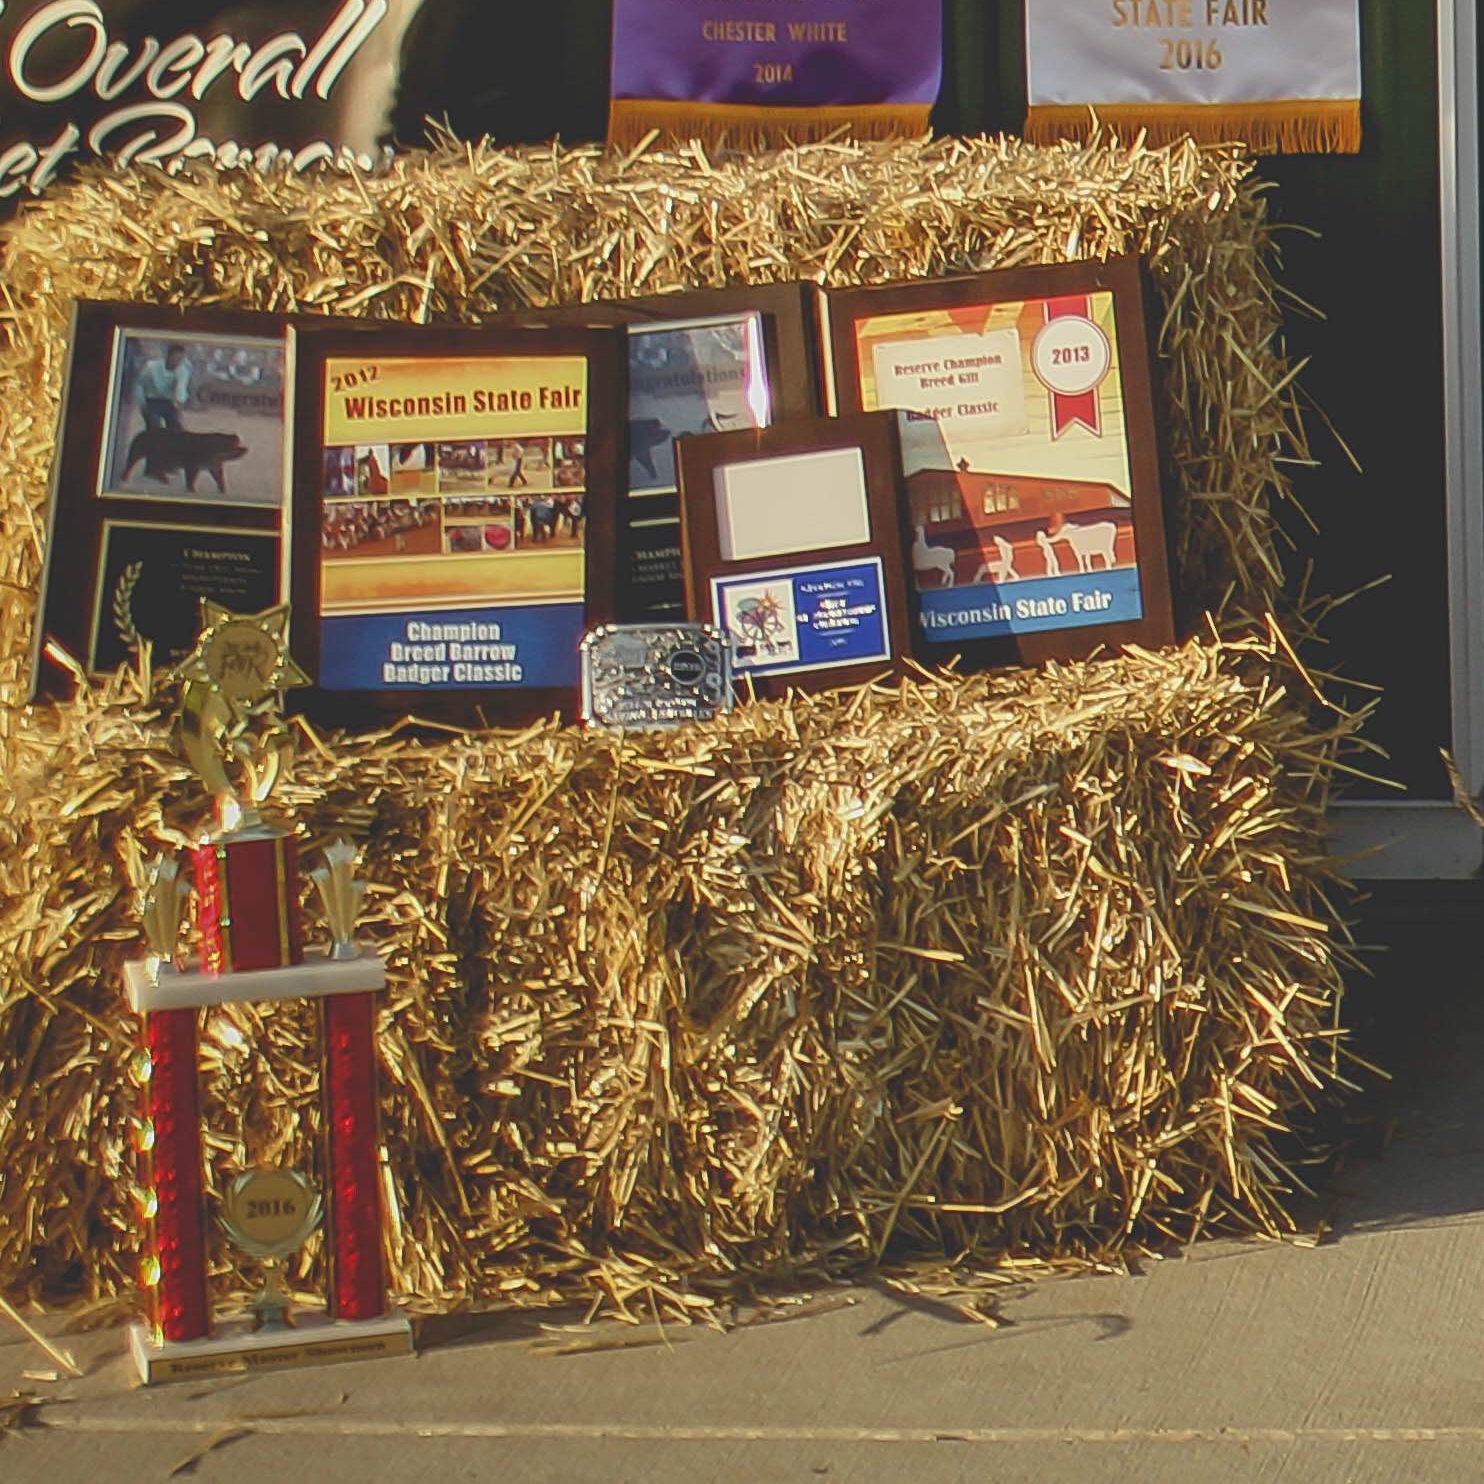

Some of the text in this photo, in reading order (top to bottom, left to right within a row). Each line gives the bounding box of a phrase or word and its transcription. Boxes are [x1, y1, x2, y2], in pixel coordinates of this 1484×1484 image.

[703, 21, 848, 42] CHESTER WHITE
[1160, 39, 1222, 70] 2016
[1053, 346, 1090, 365] 2013
[345, 386, 581, 420] Wisconsin State Fair
[1016, 590, 1112, 619] State Fair
[407, 621, 500, 643] Champion
[450, 643, 516, 662] Barrow
[383, 663, 522, 684] Badger Classic
[247, 1200, 296, 1219] 2016
